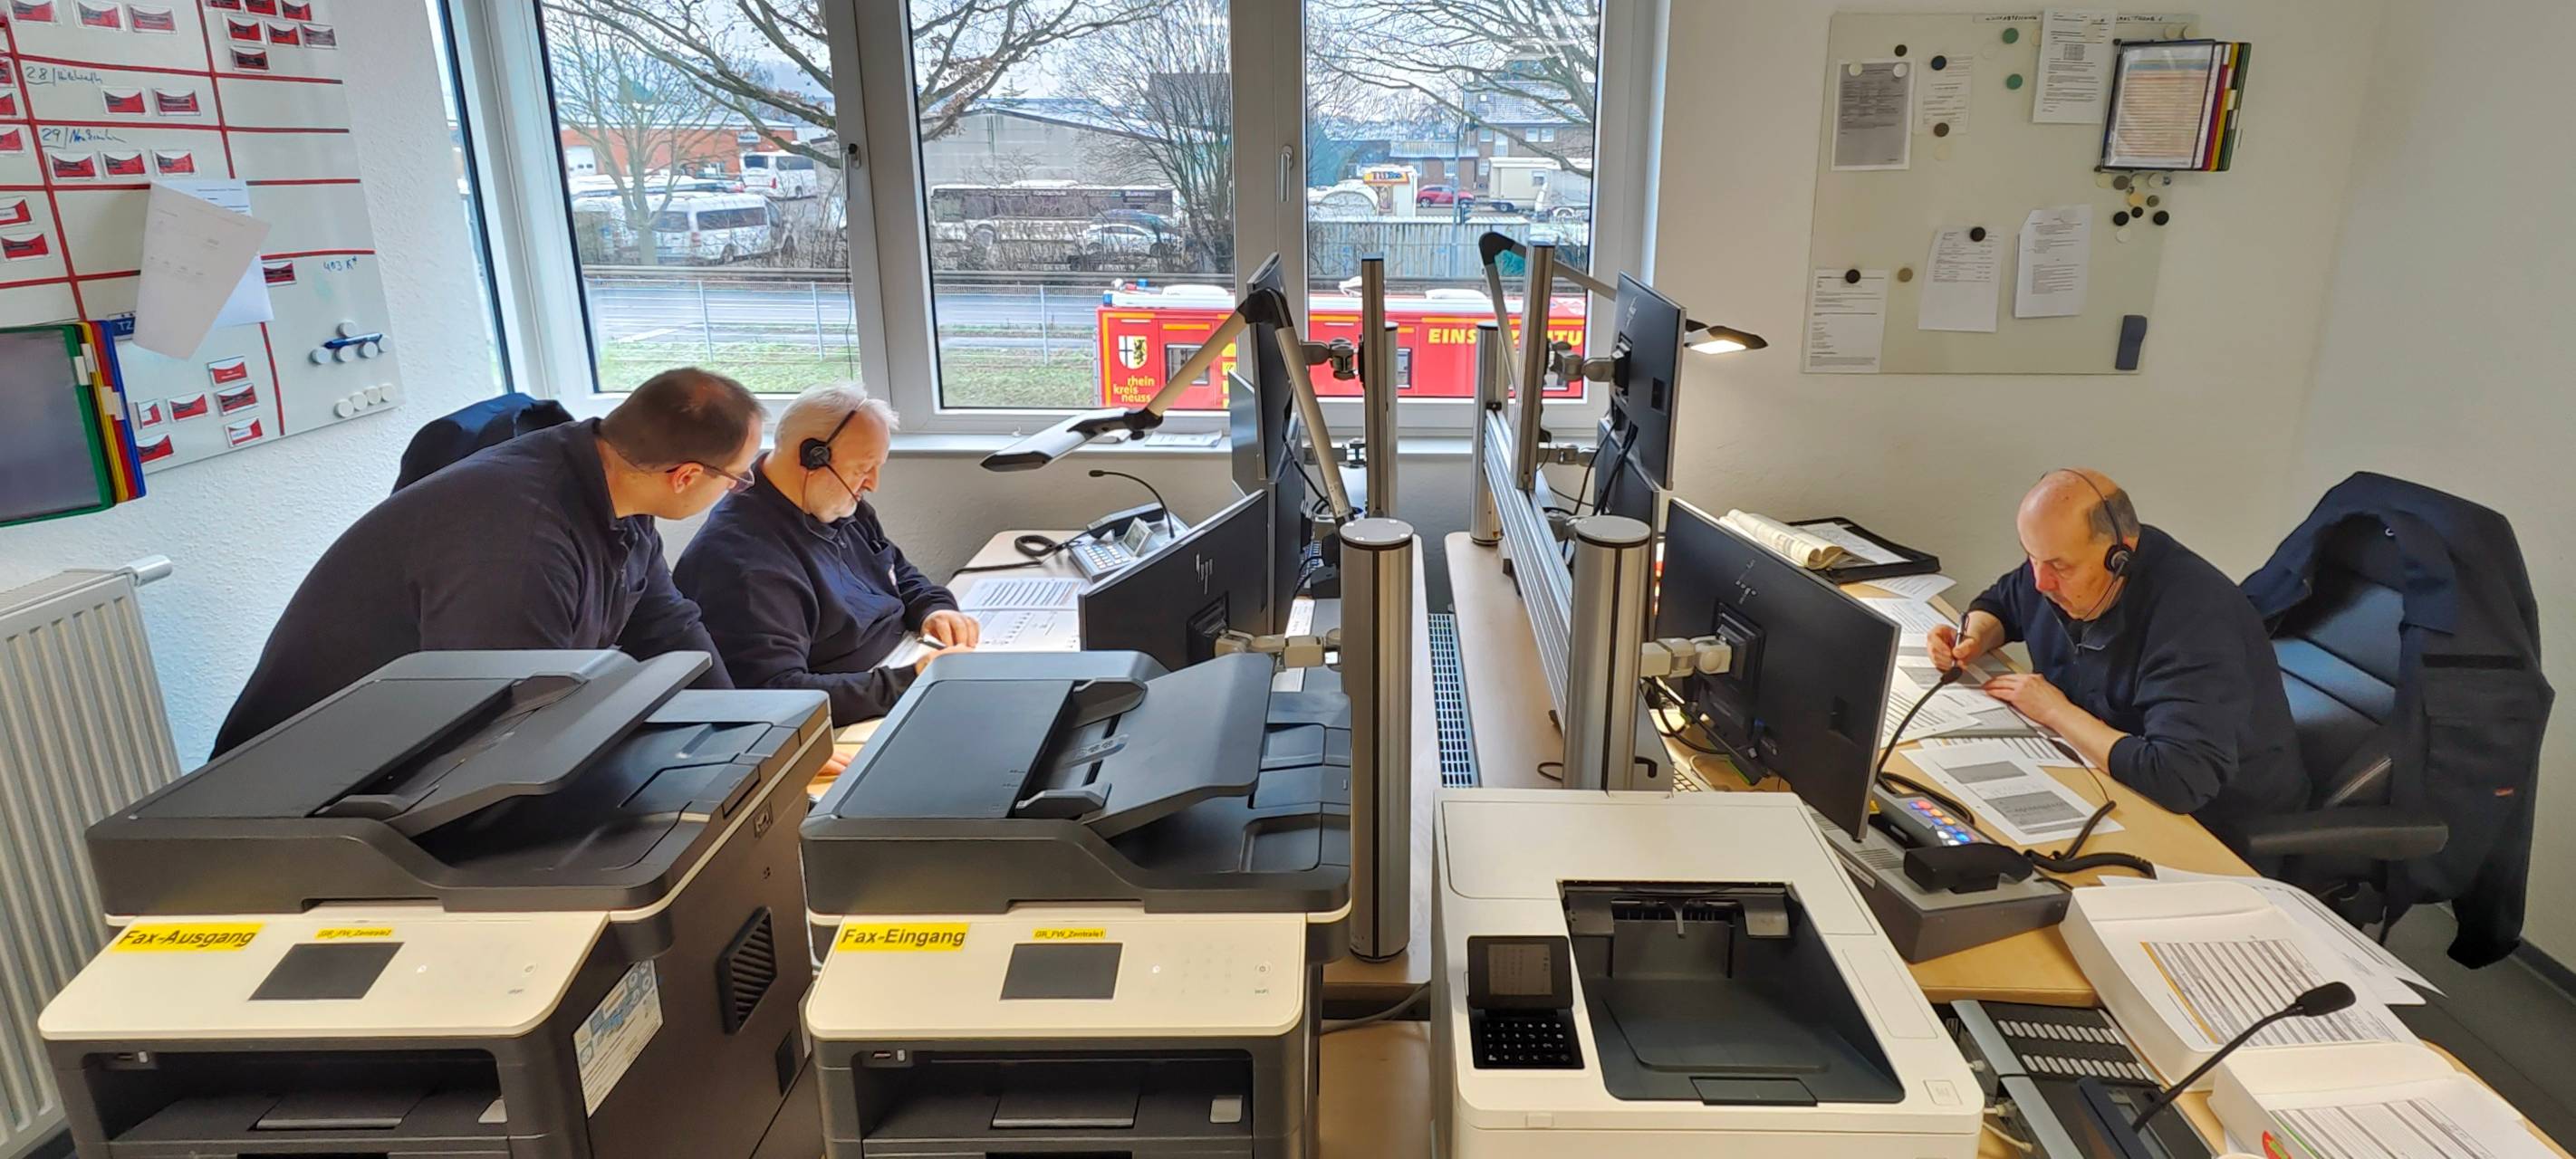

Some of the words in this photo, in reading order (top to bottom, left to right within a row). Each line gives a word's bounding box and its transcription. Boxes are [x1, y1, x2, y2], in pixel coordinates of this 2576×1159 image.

[26, 66, 48, 81] 28
[42, 128, 61, 142] 29
[1127, 375, 1156, 387] rhein
[1113, 383, 1139, 395] kreis
[1121, 393, 1151, 403] neuss
[117, 930, 257, 948] Fax-Ausgang
[841, 929, 966, 947] Fax-Eingang
